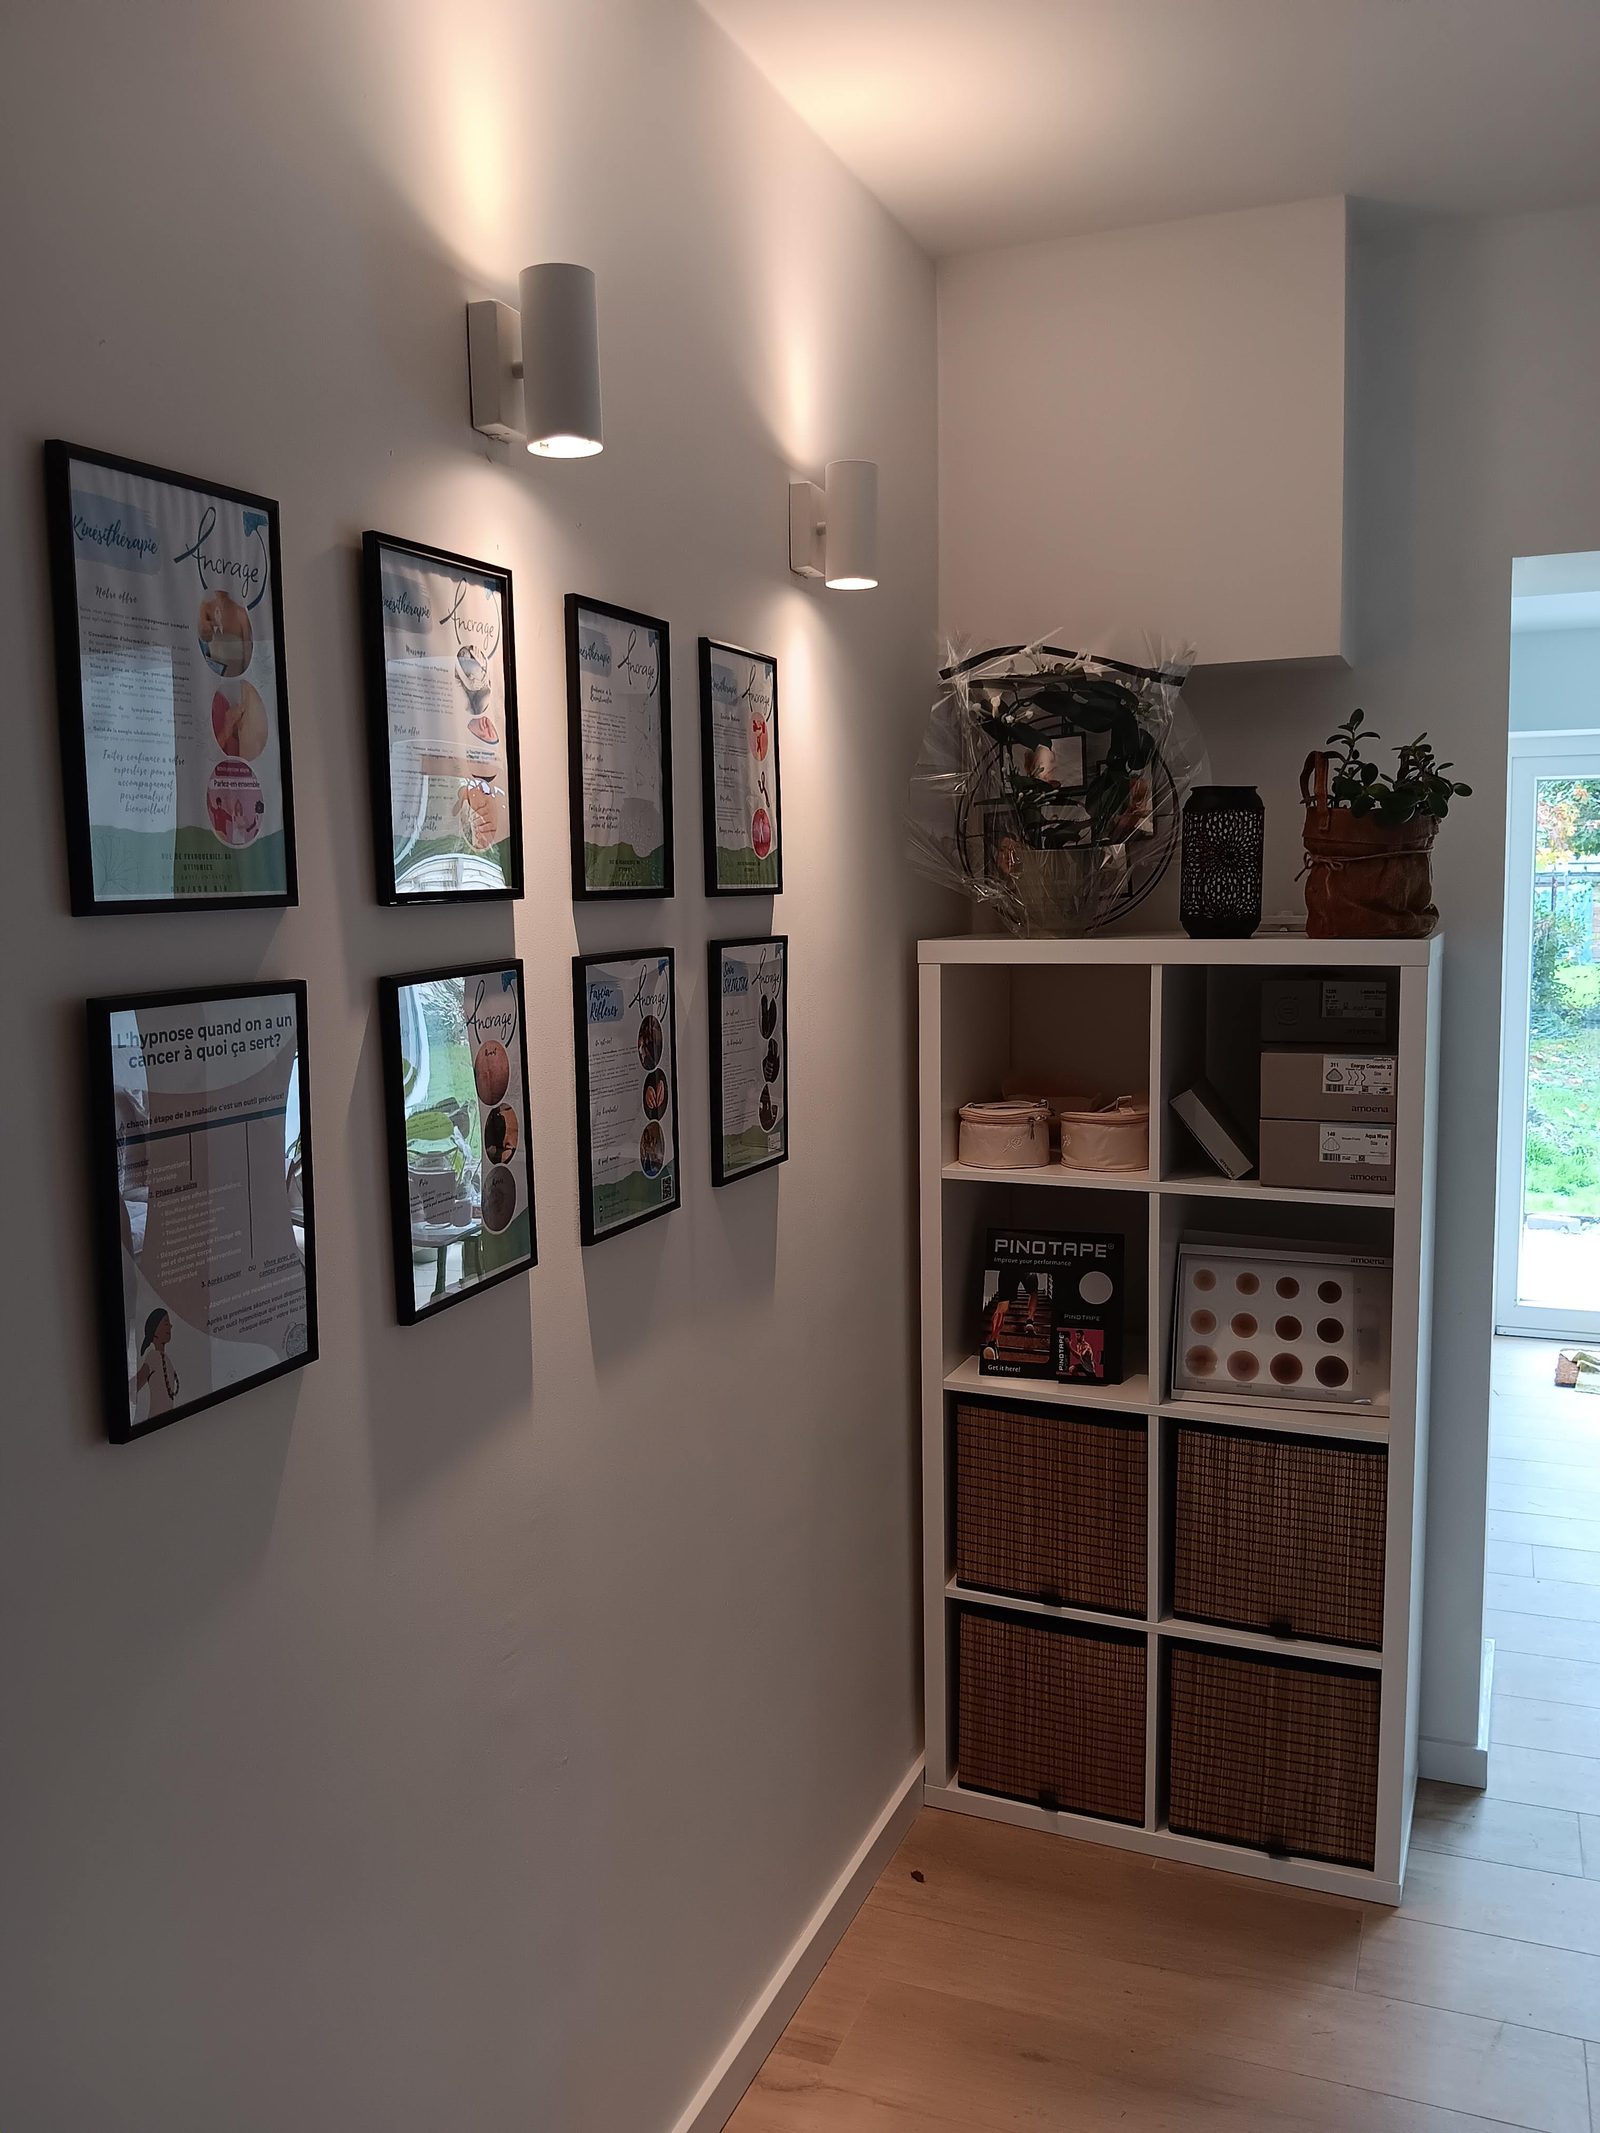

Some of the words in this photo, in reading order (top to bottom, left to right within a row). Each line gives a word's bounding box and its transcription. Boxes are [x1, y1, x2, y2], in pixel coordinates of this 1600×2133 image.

[117, 1027, 194, 1050] L'hypnose
[198, 1018, 242, 1041] quand
[244, 1018, 262, 1032] on
[265, 1018, 272, 1029] a
[276, 1015, 292, 1028] un
[128, 1051, 180, 1068] cancer
[184, 1045, 192, 1060] à
[196, 1040, 228, 1059] quoi
[231, 1042, 246, 1058] ça
[249, 1033, 281, 1051] sert?
[1351, 1105, 1389, 1113] amoena
[126, 1118, 152, 1131] chaque
[154, 1112, 174, 1126] étape
[175, 1111, 184, 1120] de
[184, 1109, 191, 1118] la
[192, 1106, 218, 1118] maladie
[219, 1102, 233, 1111] c'est
[233, 1100, 243, 1109] un
[1350, 1174, 1387, 1182] amoena
[994, 1257, 1018, 1265] Improve
[1034, 1258, 1072, 1267] performance
[1350, 1257, 1385, 1265] amoena
[224, 1270, 242, 1280] cancer
[207, 1315, 222, 1327] Après
[229, 1305, 252, 1320] première
